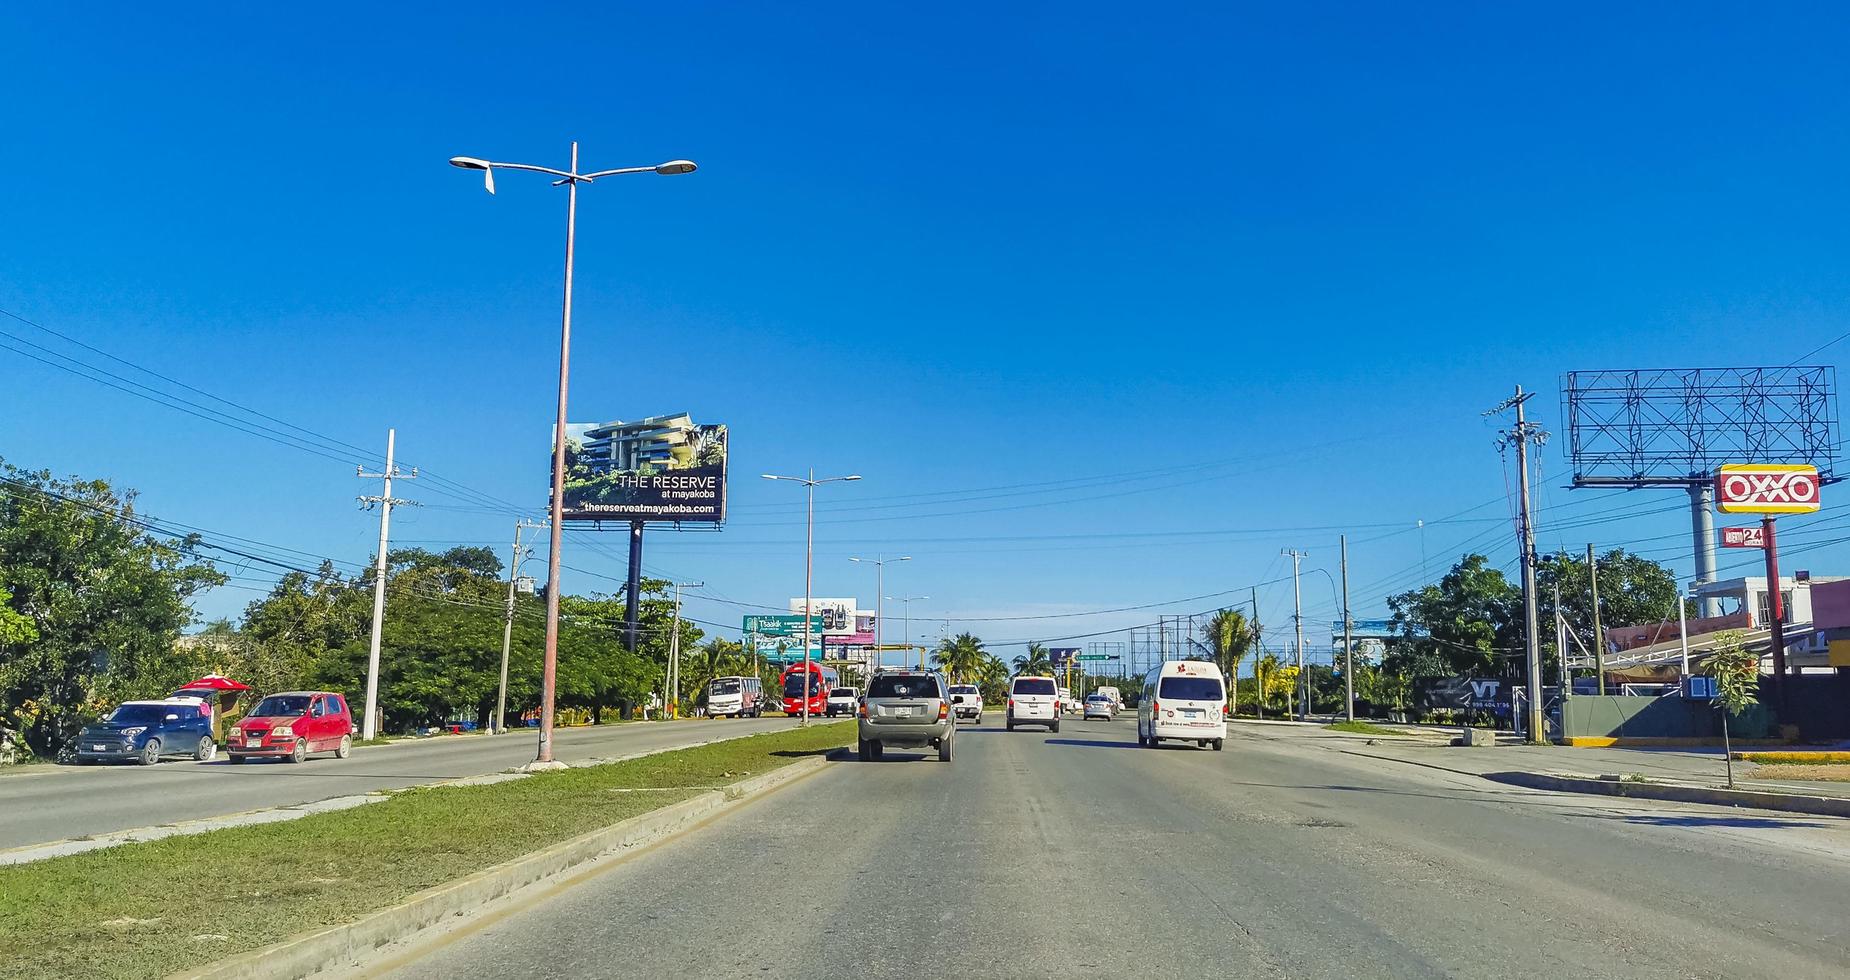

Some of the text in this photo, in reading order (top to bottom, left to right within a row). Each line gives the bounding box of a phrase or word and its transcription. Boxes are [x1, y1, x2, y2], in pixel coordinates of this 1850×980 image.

[619, 476, 716, 488] THE RESERVE
[1725, 474, 1815, 502] OXXO
[661, 490, 714, 499] at mayakoba
[585, 504, 714, 514] thereserveatmayakoba.com
[1744, 529, 1762, 540] 24
[1471, 681, 1500, 698] VT
